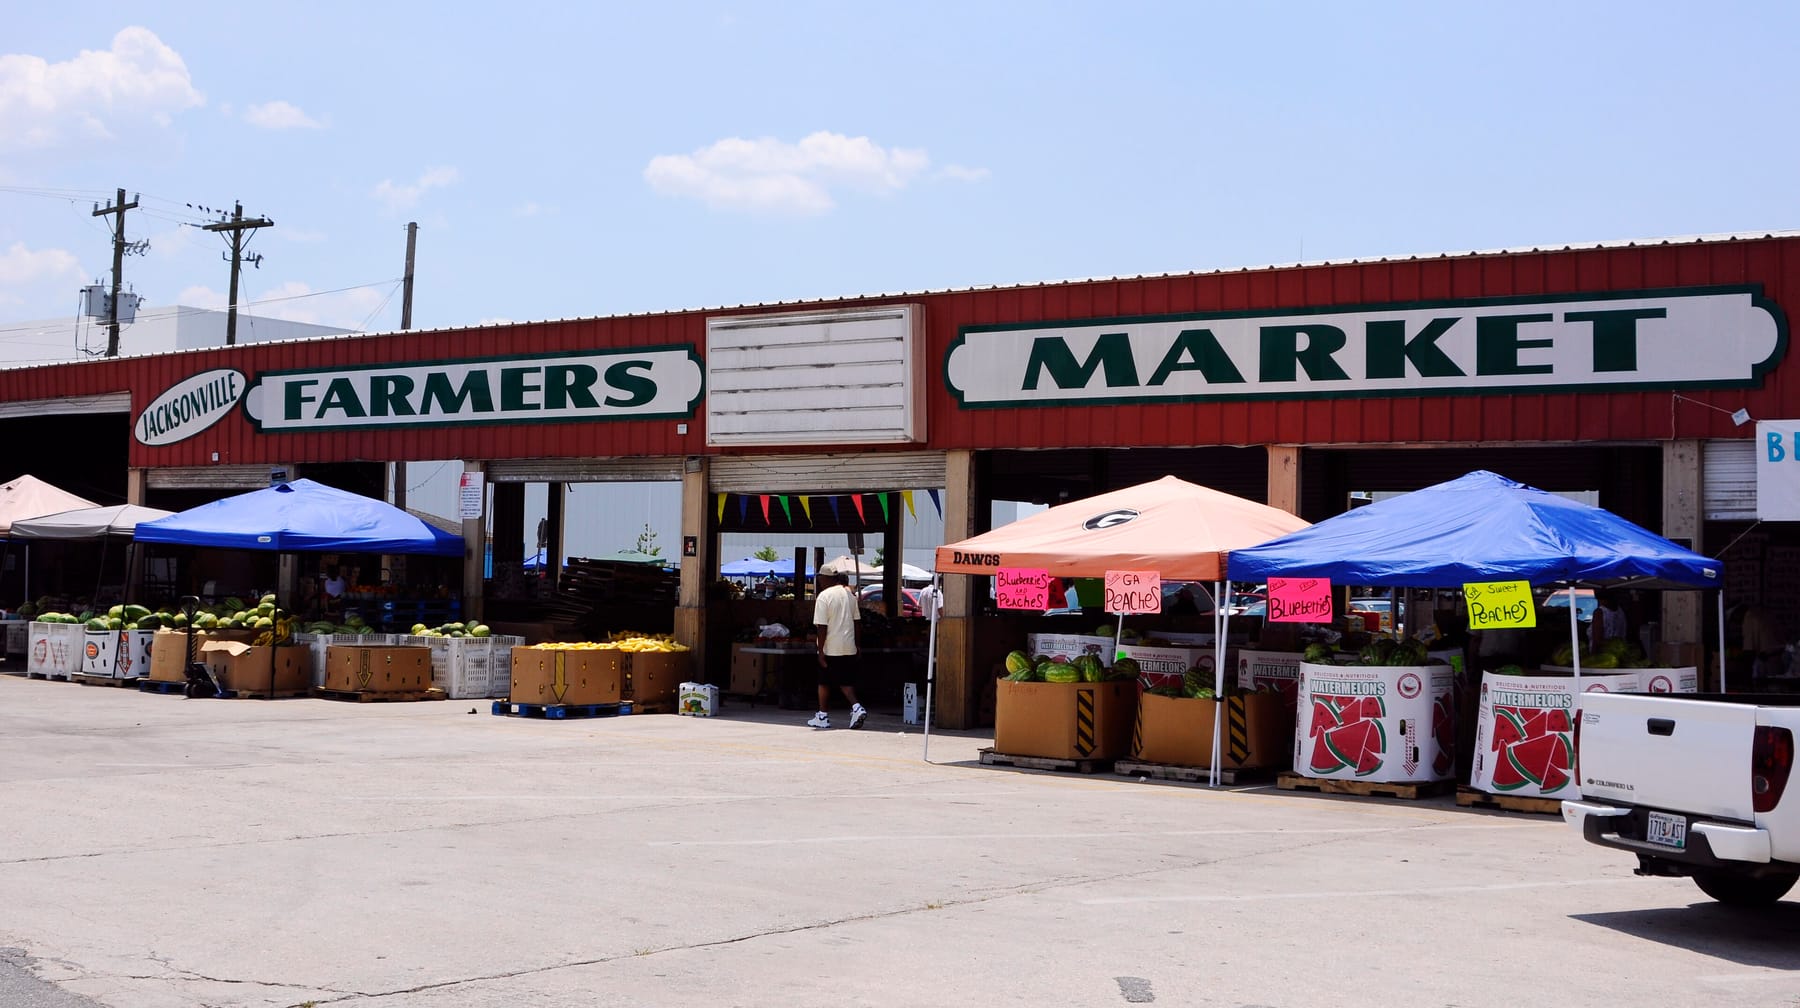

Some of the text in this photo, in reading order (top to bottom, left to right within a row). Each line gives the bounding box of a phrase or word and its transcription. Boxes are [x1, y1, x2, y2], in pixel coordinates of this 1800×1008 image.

[1021, 307, 1667, 390] MARKET
[284, 360, 657, 421] FARMERS
[142, 371, 238, 443] JACKSONVILLE
[953, 551, 1000, 566] DAWGS
[1123, 574, 1140, 586] GA
[1488, 583, 1518, 594] Sweet
[1137, 659, 1187, 674] TERMELONS
[1310, 679, 1386, 695] WATERMELONS
[1491, 690, 1572, 708] WATERMELONS
